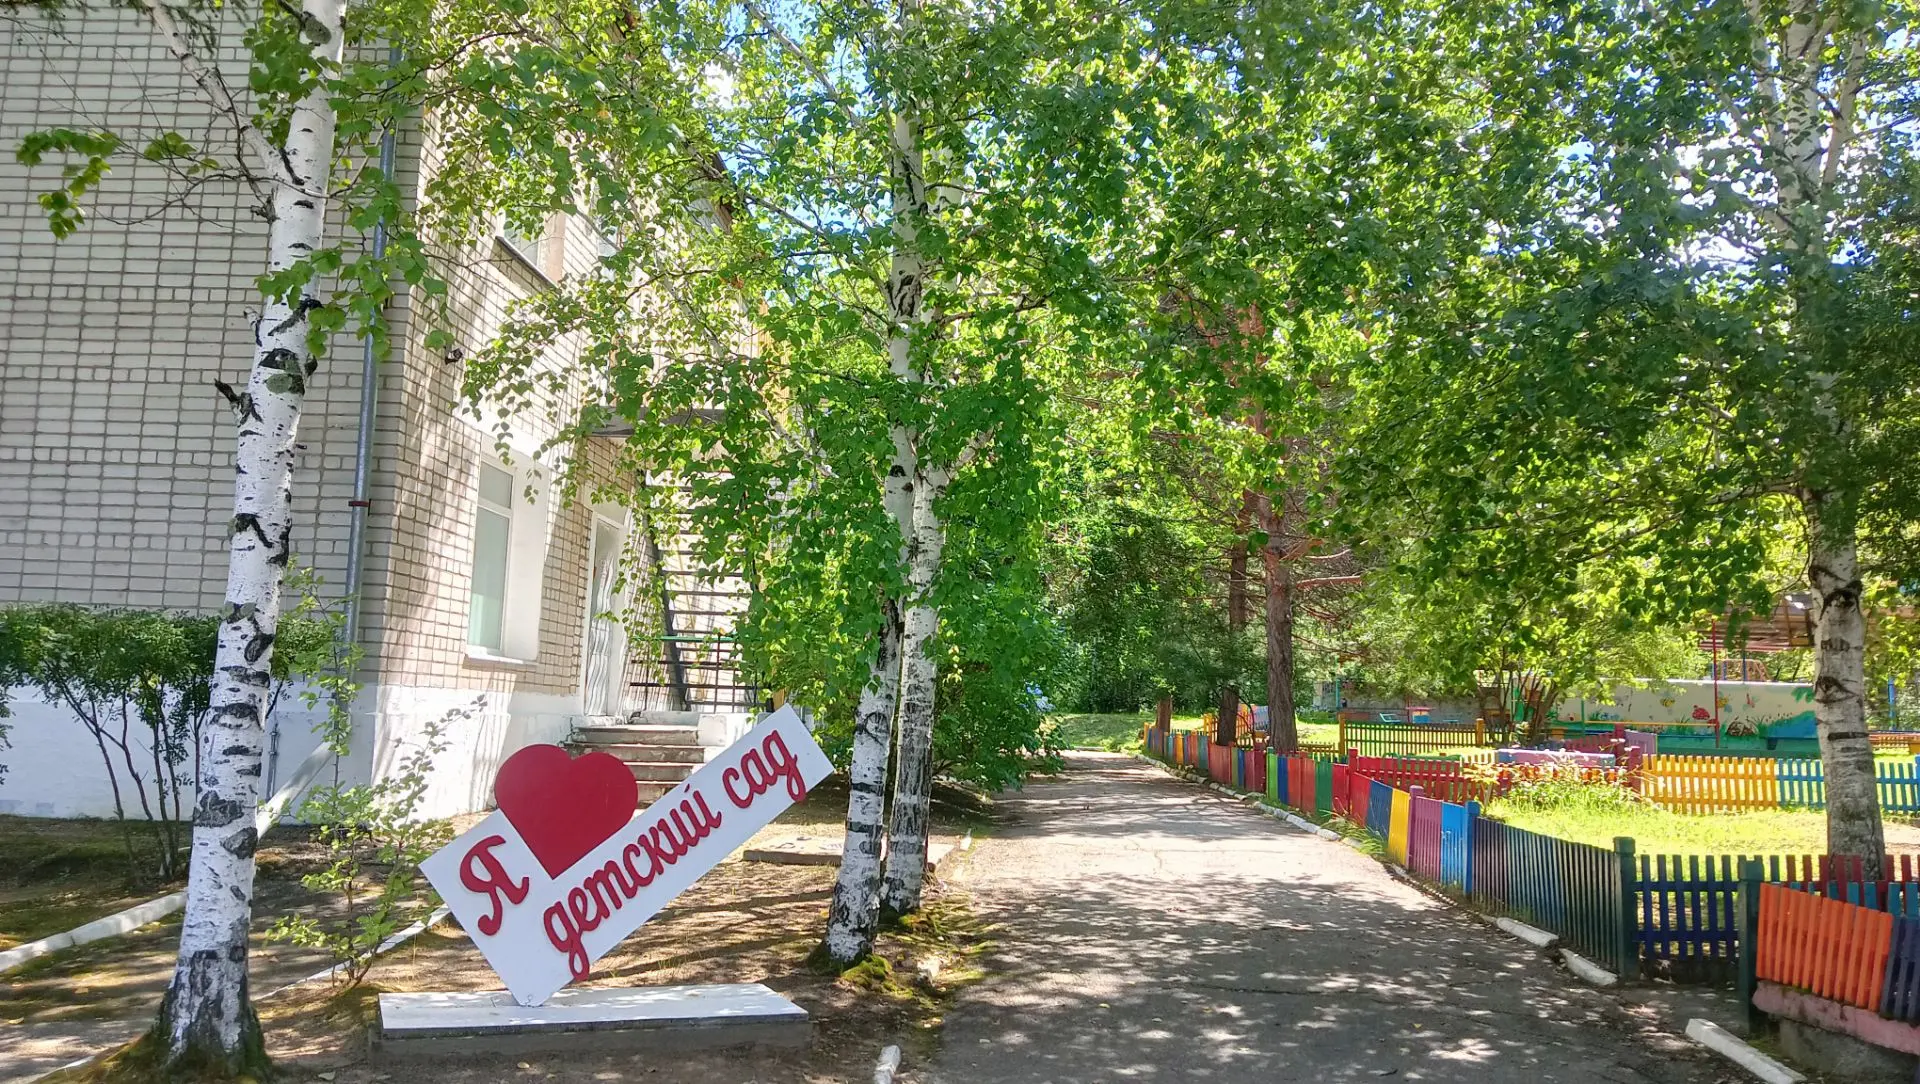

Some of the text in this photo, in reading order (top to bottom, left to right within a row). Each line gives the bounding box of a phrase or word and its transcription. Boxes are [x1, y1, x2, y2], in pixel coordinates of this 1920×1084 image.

[459, 835, 529, 936] Я
[543, 729, 807, 982] детский сад
